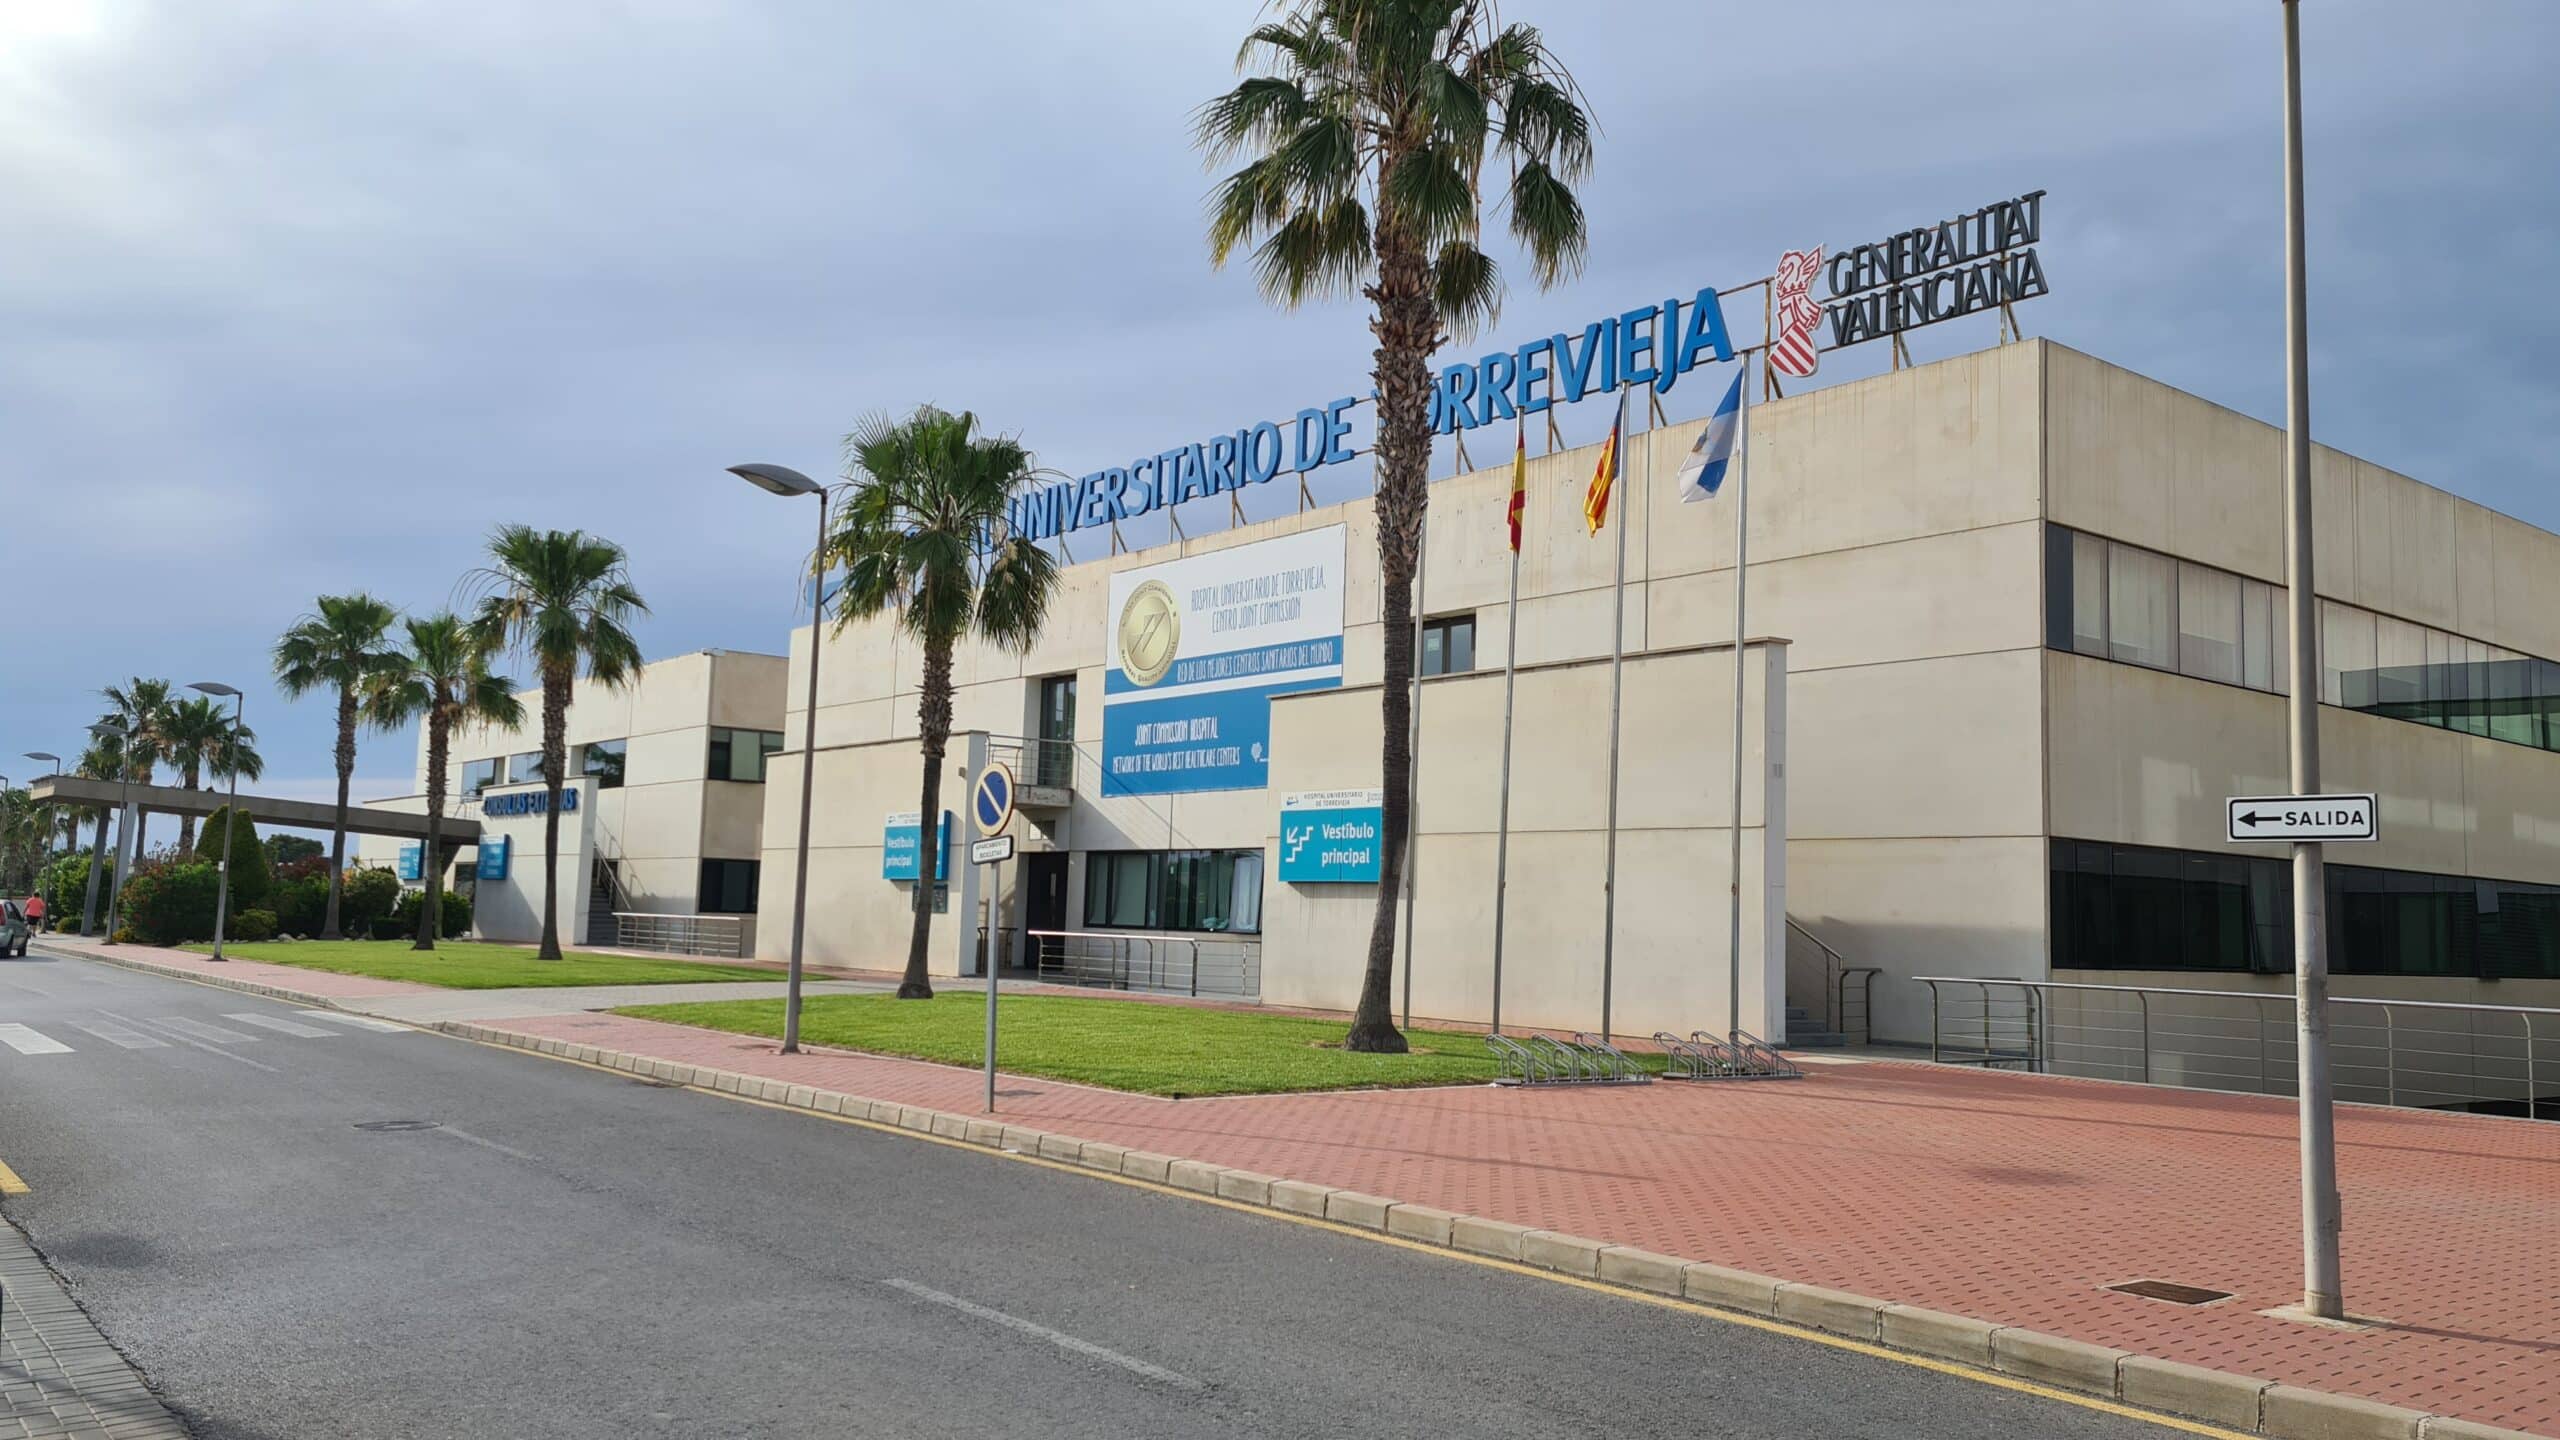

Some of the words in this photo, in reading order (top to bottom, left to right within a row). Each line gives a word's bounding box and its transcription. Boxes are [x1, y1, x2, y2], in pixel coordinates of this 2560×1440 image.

[1828, 189, 2047, 297] GENERALITAT
[1828, 247, 2049, 346] VALENCIANA
[1007, 420, 1282, 542] UNIVERSITARIO
[1294, 398, 1356, 473] DE
[1371, 287, 1735, 438] RREVIEJA
[1191, 584, 1219, 612] HOSPITAL
[1220, 575, 1270, 607] UNIVERSITARIO
[1271, 573, 1280, 598] DE
[1212, 608, 1238, 634] CENTRO
[1239, 603, 1258, 630] JOINT
[1260, 597, 1302, 626] COMMISSION
[1207, 656, 1232, 679] MEJORES
[1233, 652, 1260, 676] CENTROS
[1261, 646, 1298, 672] SANITARIOS
[1299, 645, 1309, 667] DEL
[1310, 641, 1333, 664] MUNDO
[1135, 723, 1152, 747] JOINT
[1152, 720, 1188, 745] COMMISSION
[1190, 716, 1218, 741] HOSPITAL
[1113, 756, 1135, 774] NETWORK
[1142, 754, 1151, 772] THE
[1216, 747, 1240, 767] CENTERS
[530, 788, 577, 814] EXTAS
[1322, 822, 1375, 840] Vestíbulo
[2285, 810, 2365, 827] SALIDA
[1322, 847, 1370, 868] principal
